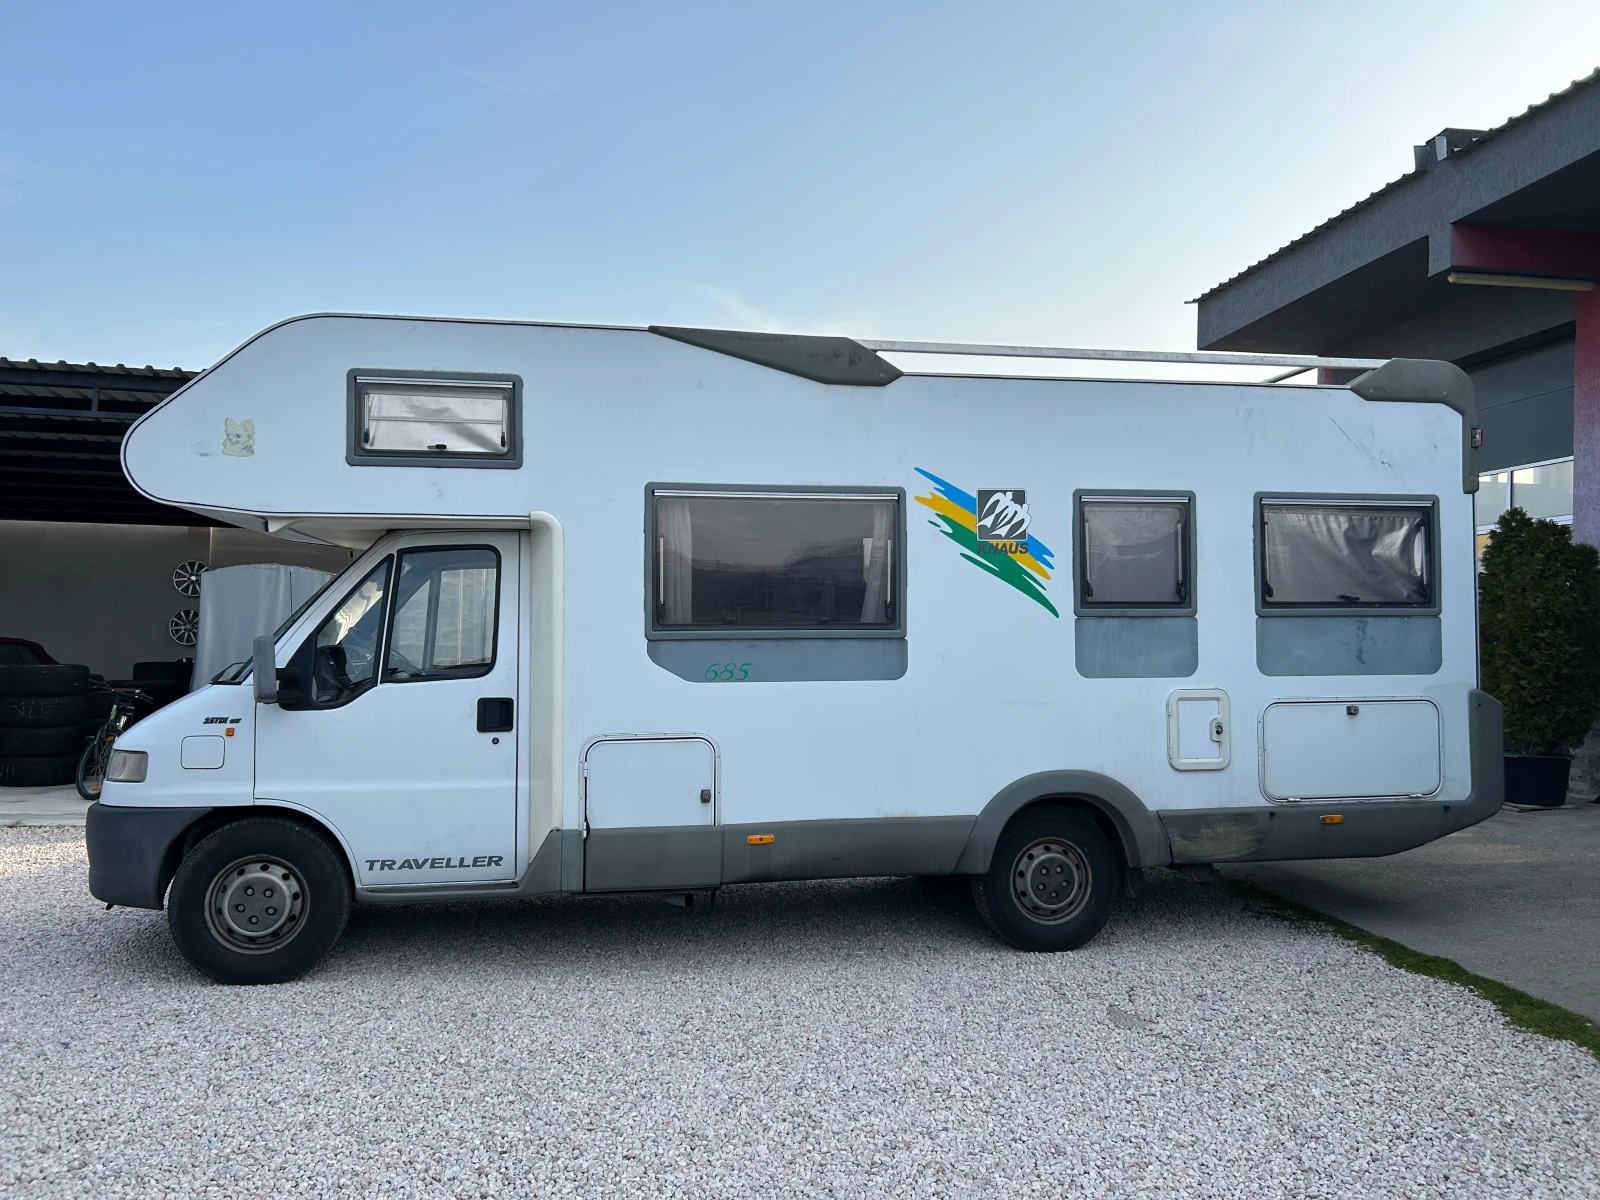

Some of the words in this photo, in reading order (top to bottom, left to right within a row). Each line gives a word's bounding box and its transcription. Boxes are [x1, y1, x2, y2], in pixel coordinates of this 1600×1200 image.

[977, 542, 1029, 555] KNAUS
[704, 662, 753, 681] 685
[365, 855, 504, 871] TRAVELLER
